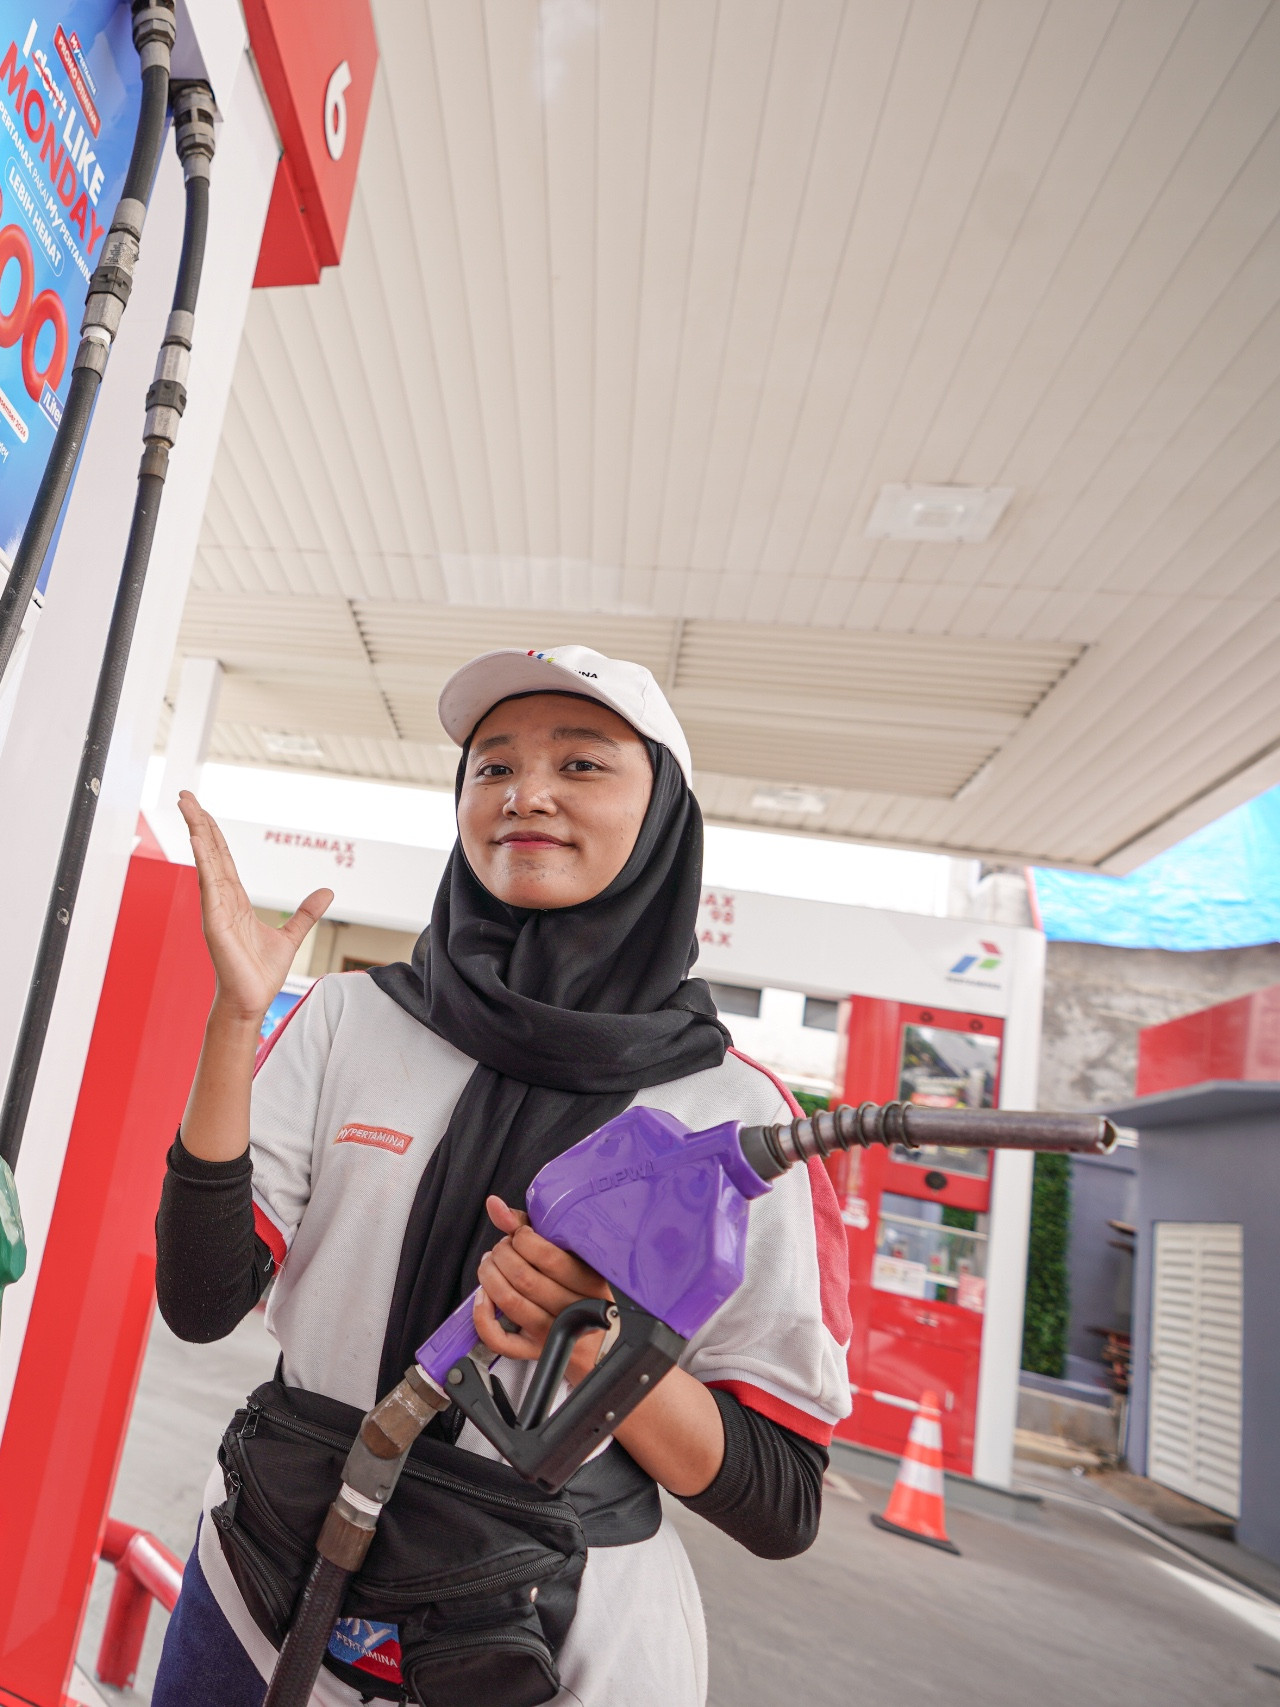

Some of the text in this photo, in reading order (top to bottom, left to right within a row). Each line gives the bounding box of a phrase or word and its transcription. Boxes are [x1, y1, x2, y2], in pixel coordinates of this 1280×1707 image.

[58, 35, 78, 80] PROMO
[22, 18, 38, 59] I
[62, 106, 105, 207] LIKE
[323, 60, 352, 161] 6
[31, 168, 50, 202] PAKAI
[8, 166, 62, 268] LEBIH HEMAT
[15, 420, 26, 438] 2024
[265, 830, 355, 853] PERTAMAX
[336, 1630, 399, 1669] PERTAMINA
